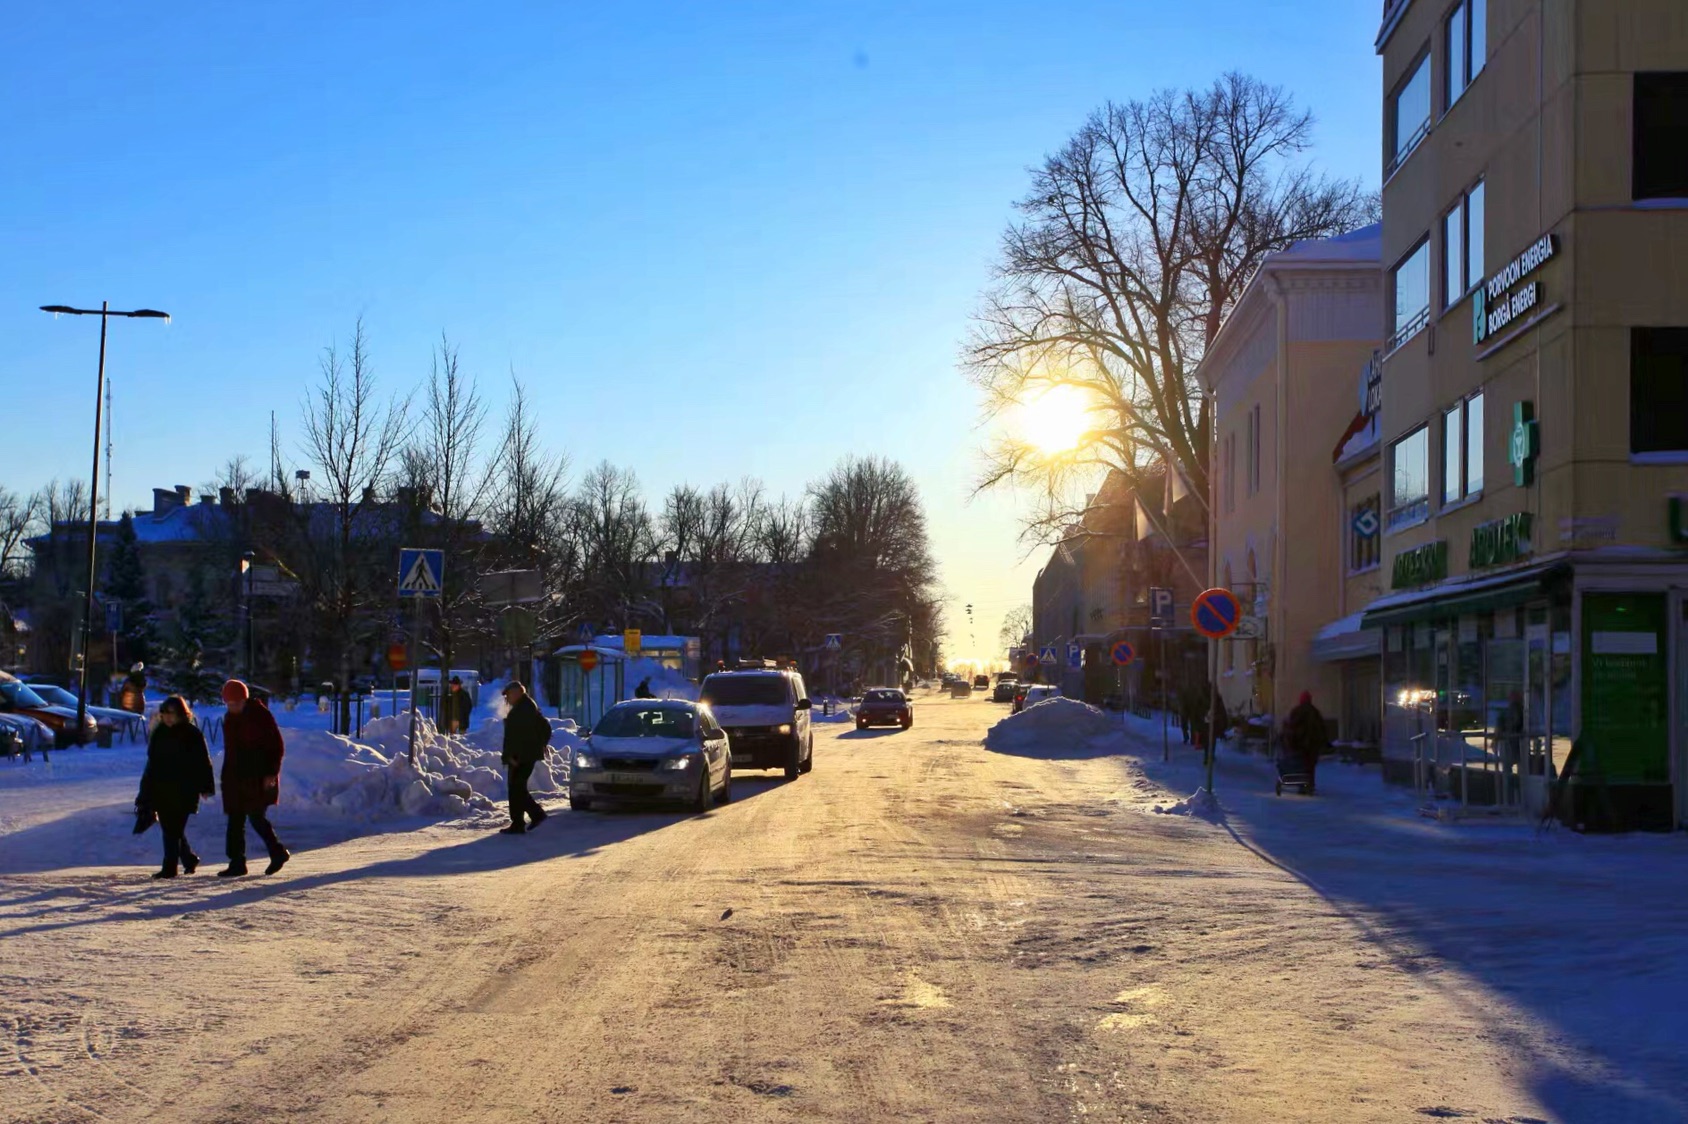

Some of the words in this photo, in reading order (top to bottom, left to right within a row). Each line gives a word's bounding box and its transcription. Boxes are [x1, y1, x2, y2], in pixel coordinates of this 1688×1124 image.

[1488, 257, 1520, 302] PORVOON
[1521, 233, 1553, 276] ENERGIA
[1488, 292, 1511, 335] BORGÅ
[1511, 281, 1536, 320] ENERGI
[1155, 590, 1172, 615] P
